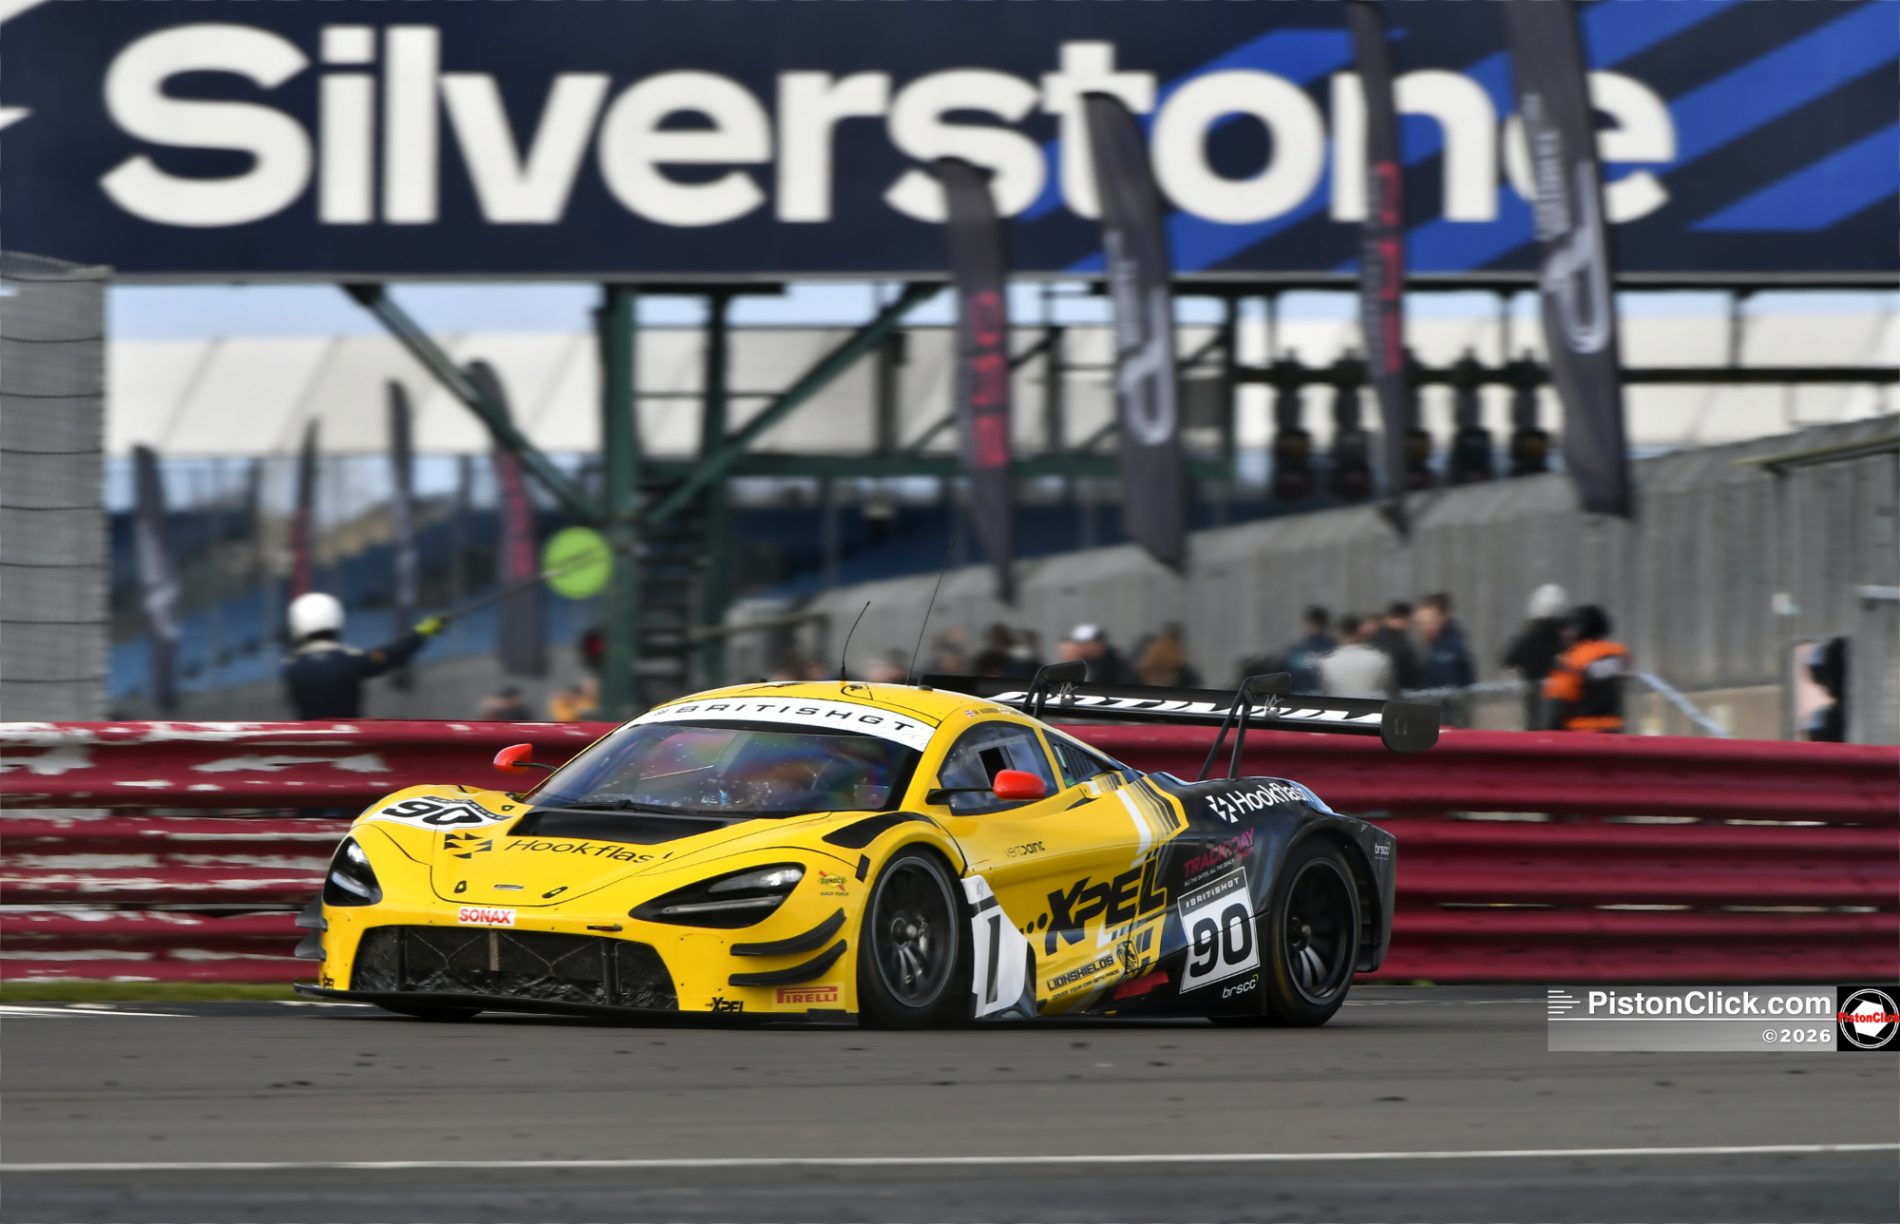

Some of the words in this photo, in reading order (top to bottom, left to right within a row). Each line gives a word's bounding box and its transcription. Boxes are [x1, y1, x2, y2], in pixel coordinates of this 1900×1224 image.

[100, 24, 1676, 227] Silverstone
[382, 801, 483, 825] 90
[504, 839, 673, 863] Hookflas
[459, 908, 515, 924] SONAX
[1045, 858, 1166, 956] XPEL
[1190, 903, 1252, 978] 90
[776, 986, 838, 1004] PIRELLI
[1222, 977, 1257, 999] brscc
